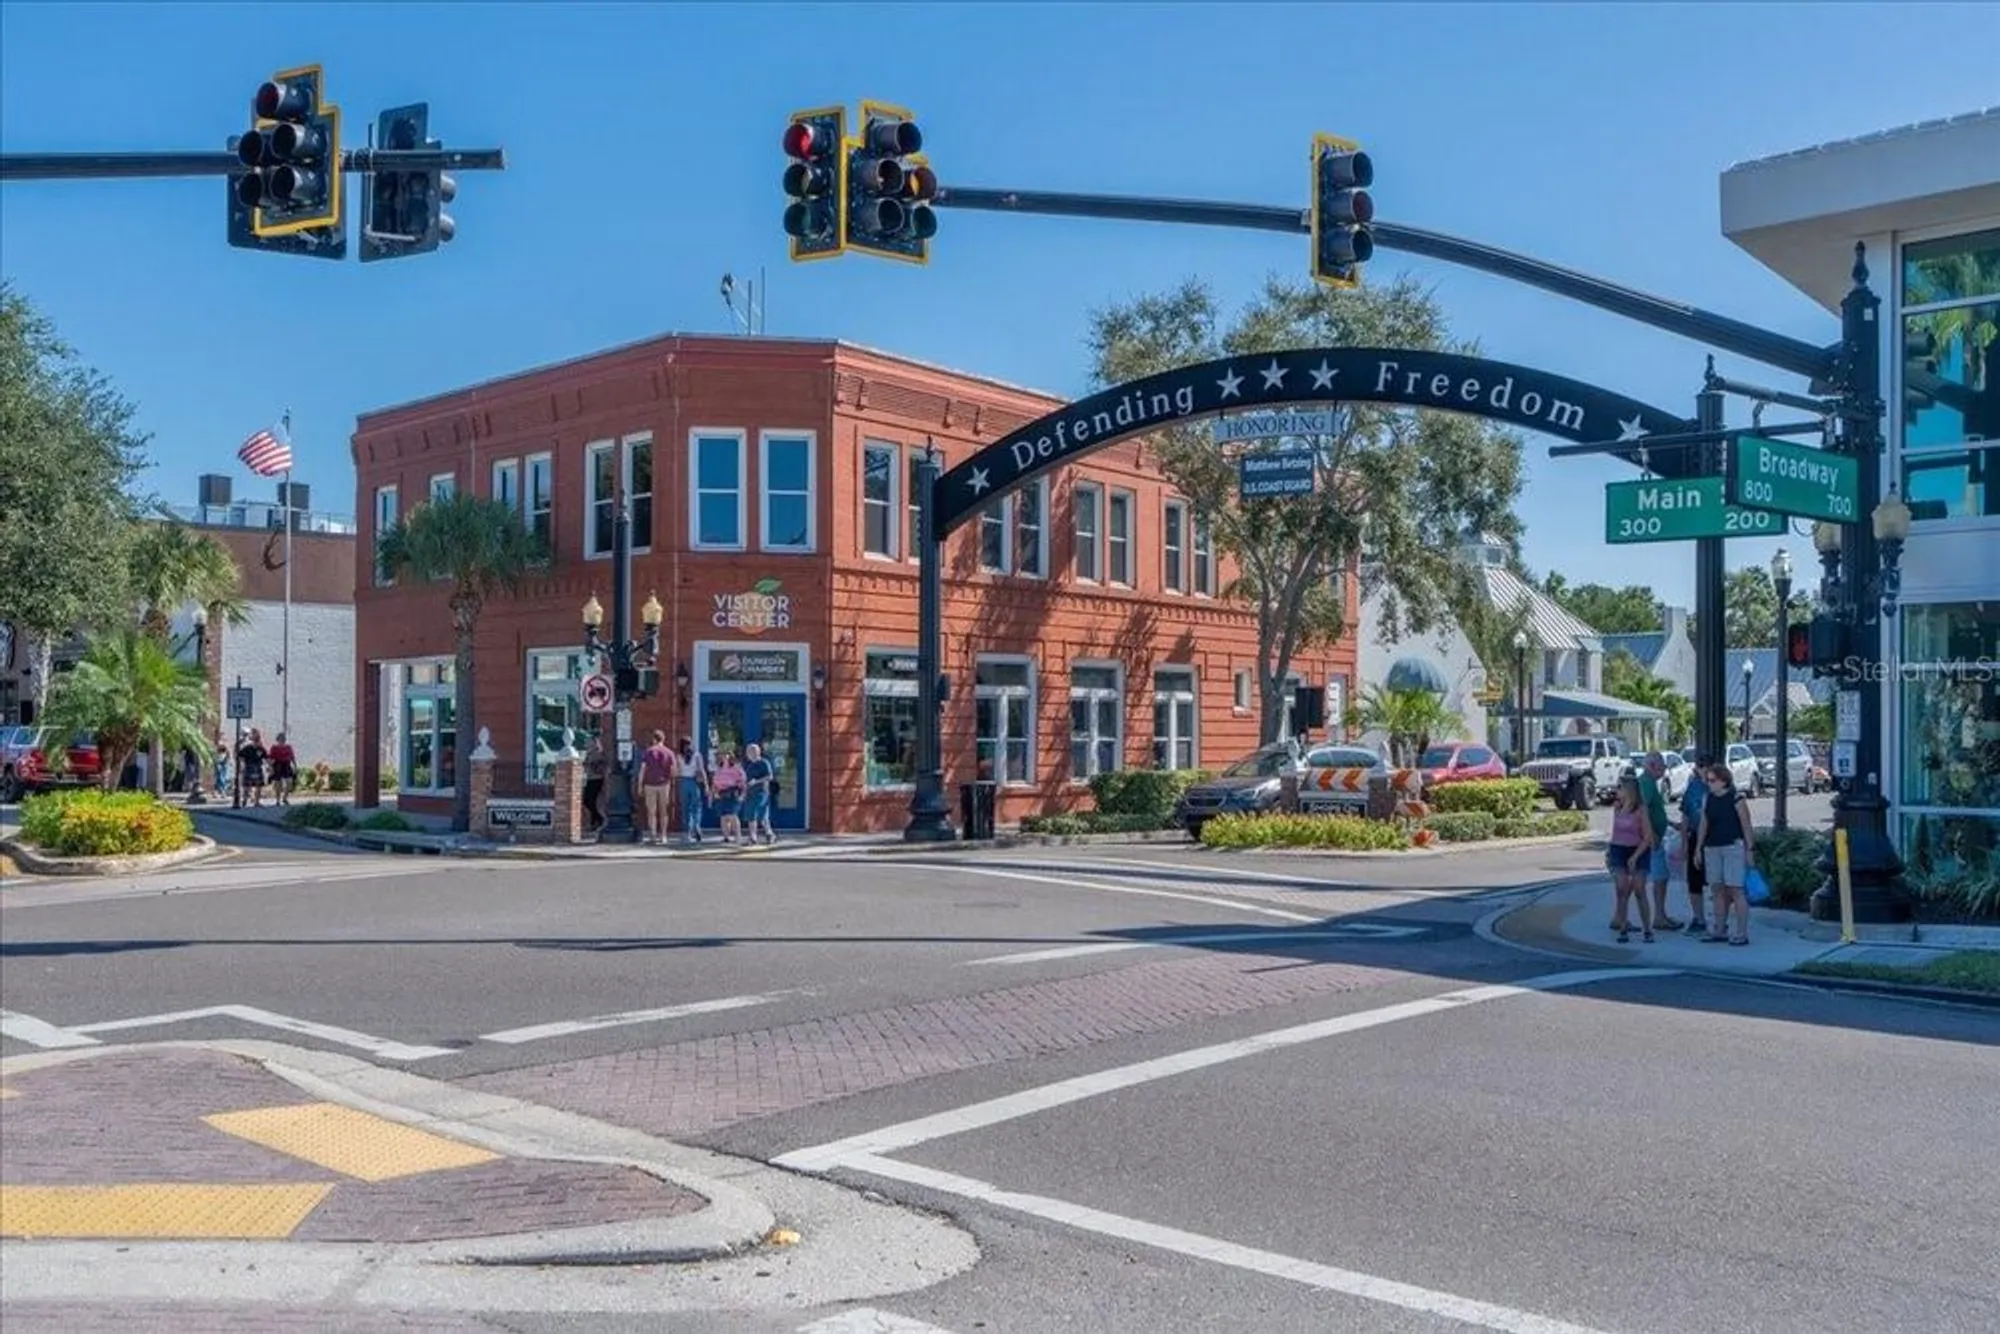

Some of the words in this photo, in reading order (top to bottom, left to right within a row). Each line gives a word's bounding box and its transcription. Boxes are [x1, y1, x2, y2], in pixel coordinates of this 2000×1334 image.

[1010, 385, 1195, 471] Defending
[1374, 361, 1586, 431] Freedom
[1226, 414, 1325, 437] HONORING
[1760, 448, 1839, 489] Broadway
[1637, 488, 1702, 511] Main
[1744, 480, 1773, 502] 800
[1827, 494, 1851, 515] 700
[1619, 518, 1662, 536] 300
[1725, 512, 1770, 530] 200
[714, 594, 789, 610] VISITOR
[712, 612, 790, 628] CENTER
